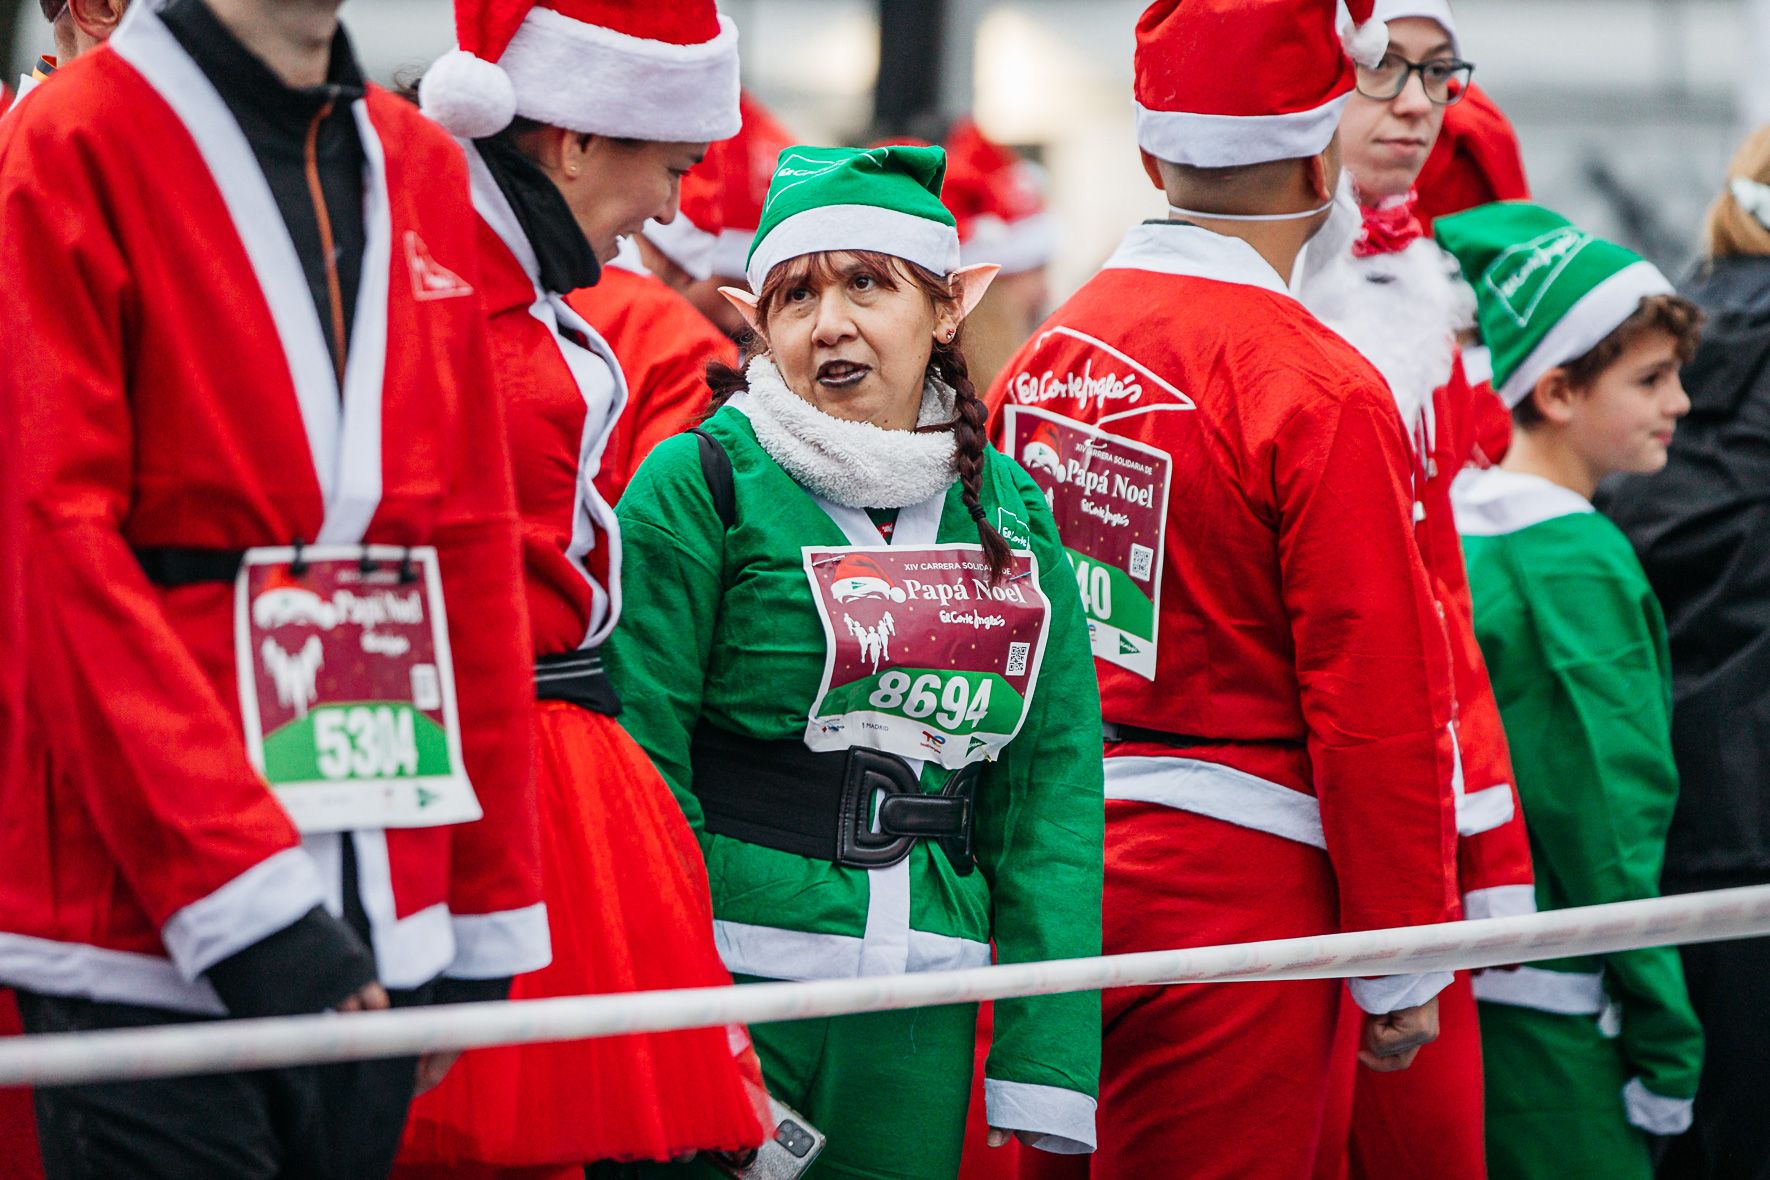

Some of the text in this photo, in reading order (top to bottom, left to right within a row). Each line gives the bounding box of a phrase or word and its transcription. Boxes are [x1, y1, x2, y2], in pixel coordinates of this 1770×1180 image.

[1113, 455, 1145, 472] SOLIDARIA
[1066, 458, 1154, 509] Papá Noel
[904, 563, 919, 571] XIV
[920, 562, 961, 571] CARRERA
[902, 577, 1028, 607] Papá Noel
[868, 670, 993, 730] 8694
[866, 723, 889, 731] MADRID
